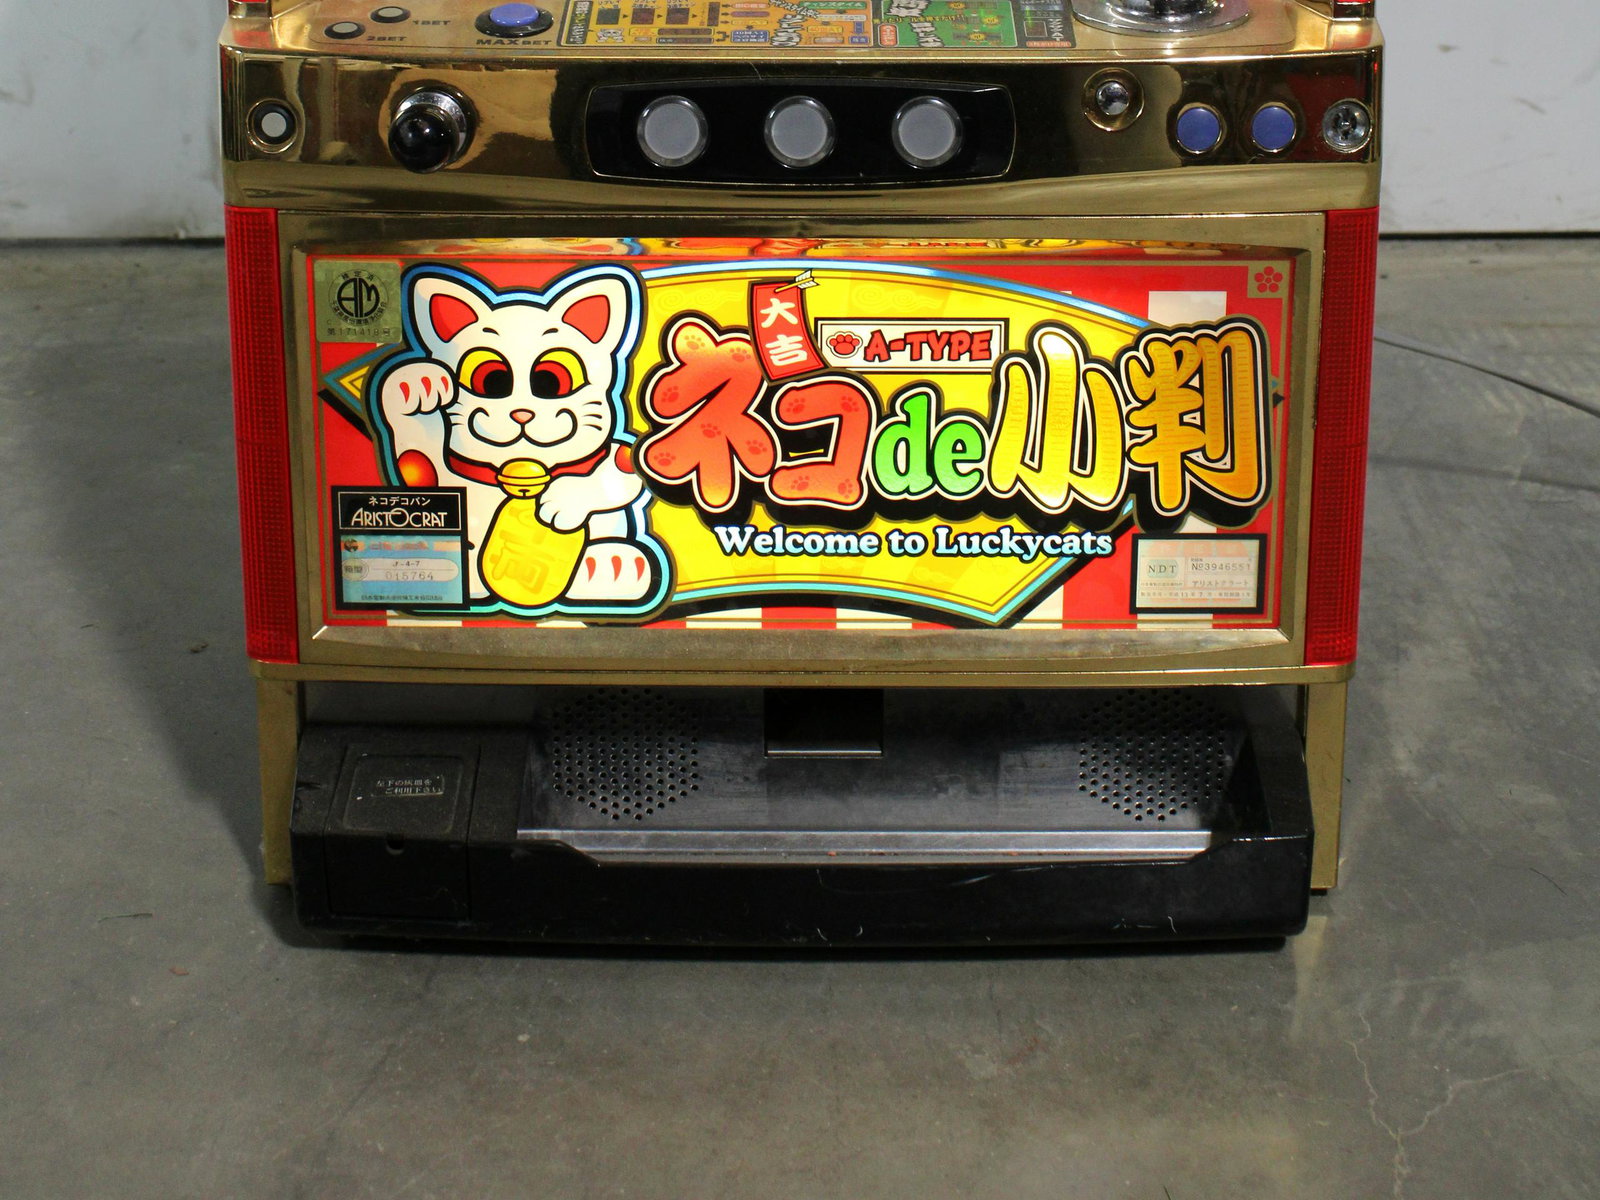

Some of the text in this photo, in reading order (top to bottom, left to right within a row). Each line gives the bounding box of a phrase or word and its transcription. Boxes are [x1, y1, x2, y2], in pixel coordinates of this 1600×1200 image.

[476, 38, 521, 46] MAX
[759, 294, 811, 367] 大吉
[863, 329, 994, 365] A-TYPE
[368, 495, 431, 507] ネコデコバン
[351, 507, 448, 528] ARISTOCRAT
[714, 526, 1114, 564] Welcome to Luckycats
[385, 571, 434, 581] 015764
[1148, 564, 1177, 574] NDT
